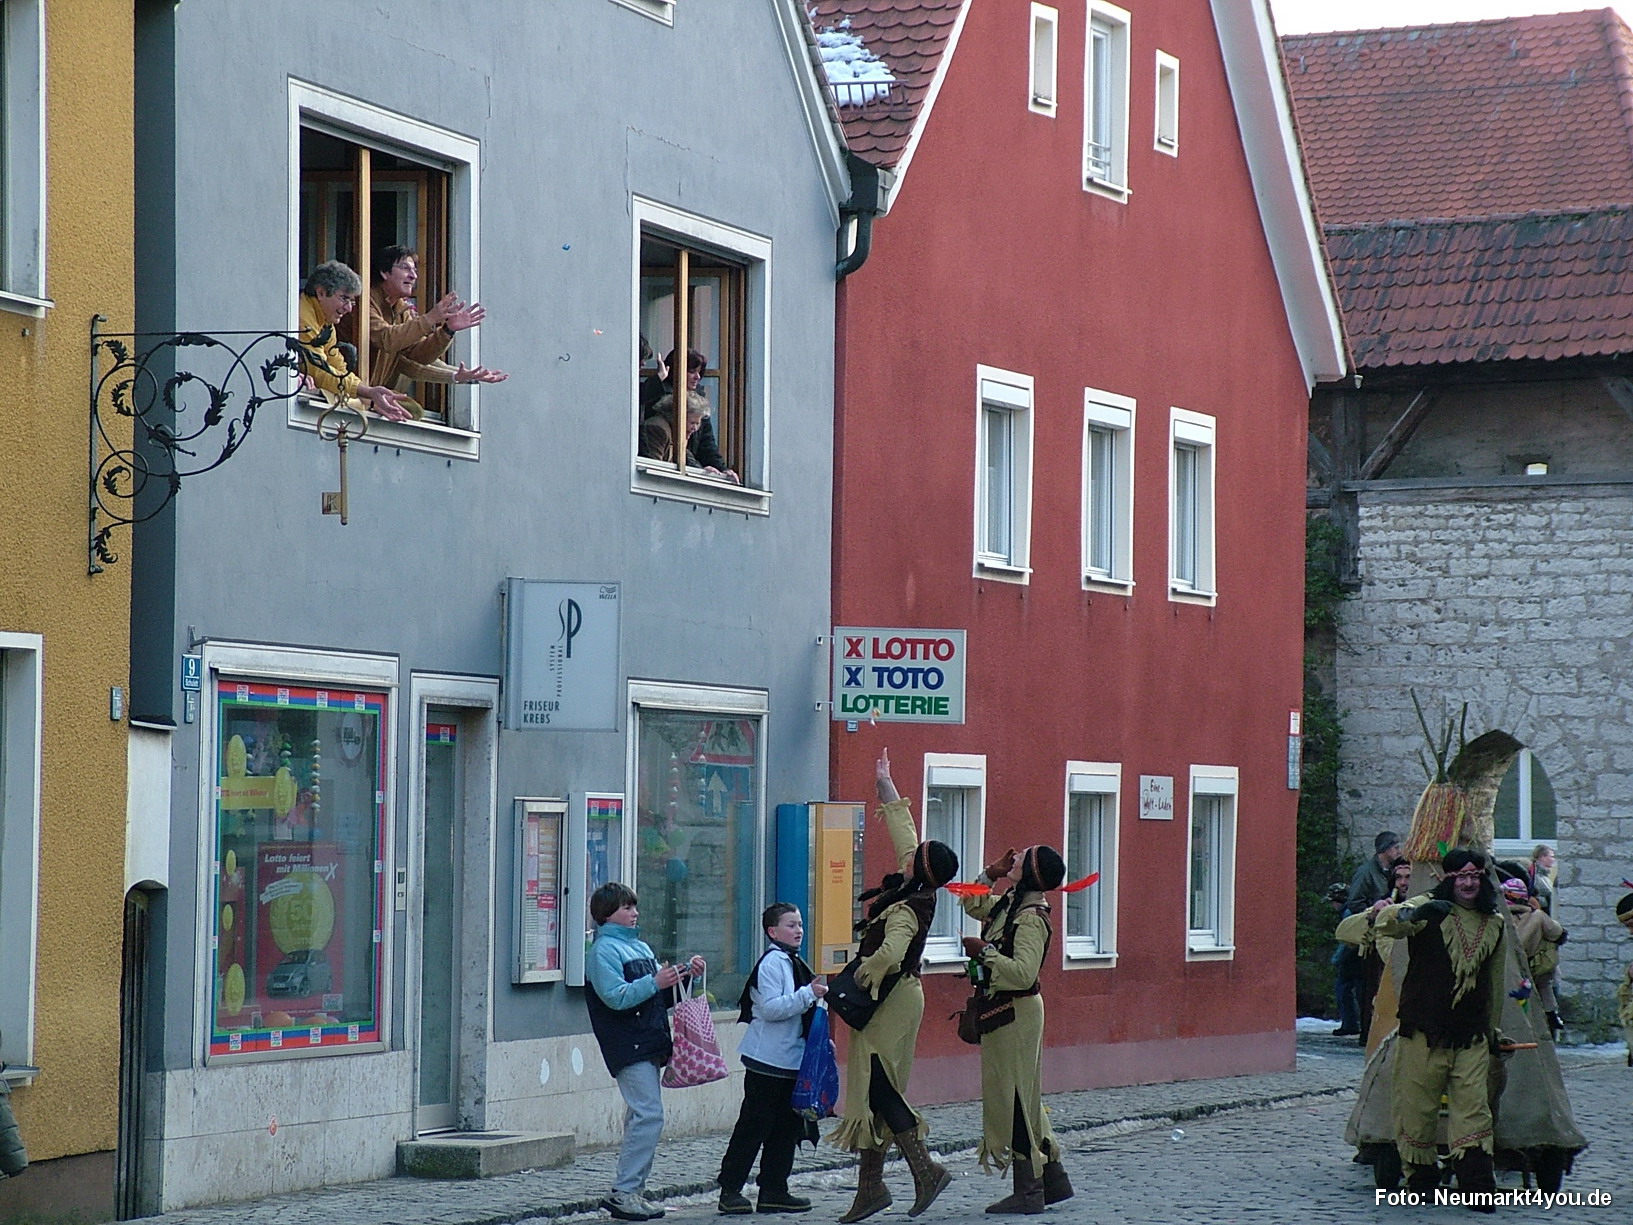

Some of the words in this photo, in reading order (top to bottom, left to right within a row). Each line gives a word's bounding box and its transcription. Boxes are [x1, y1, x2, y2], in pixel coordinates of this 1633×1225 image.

[872, 637, 955, 661] LOTTO
[188, 658, 196, 676] 9
[556, 645, 564, 697] PROFESSIONAL
[872, 666, 944, 690] TOTO
[523, 700, 560, 711] FRISEUR
[841, 694, 949, 715] LOTTERIE
[523, 714, 551, 724] KREBS
[265, 854, 287, 863] Lotto
[289, 853, 311, 863] feiert
[276, 864, 291, 873] mit
[292, 864, 330, 873] Millionen
